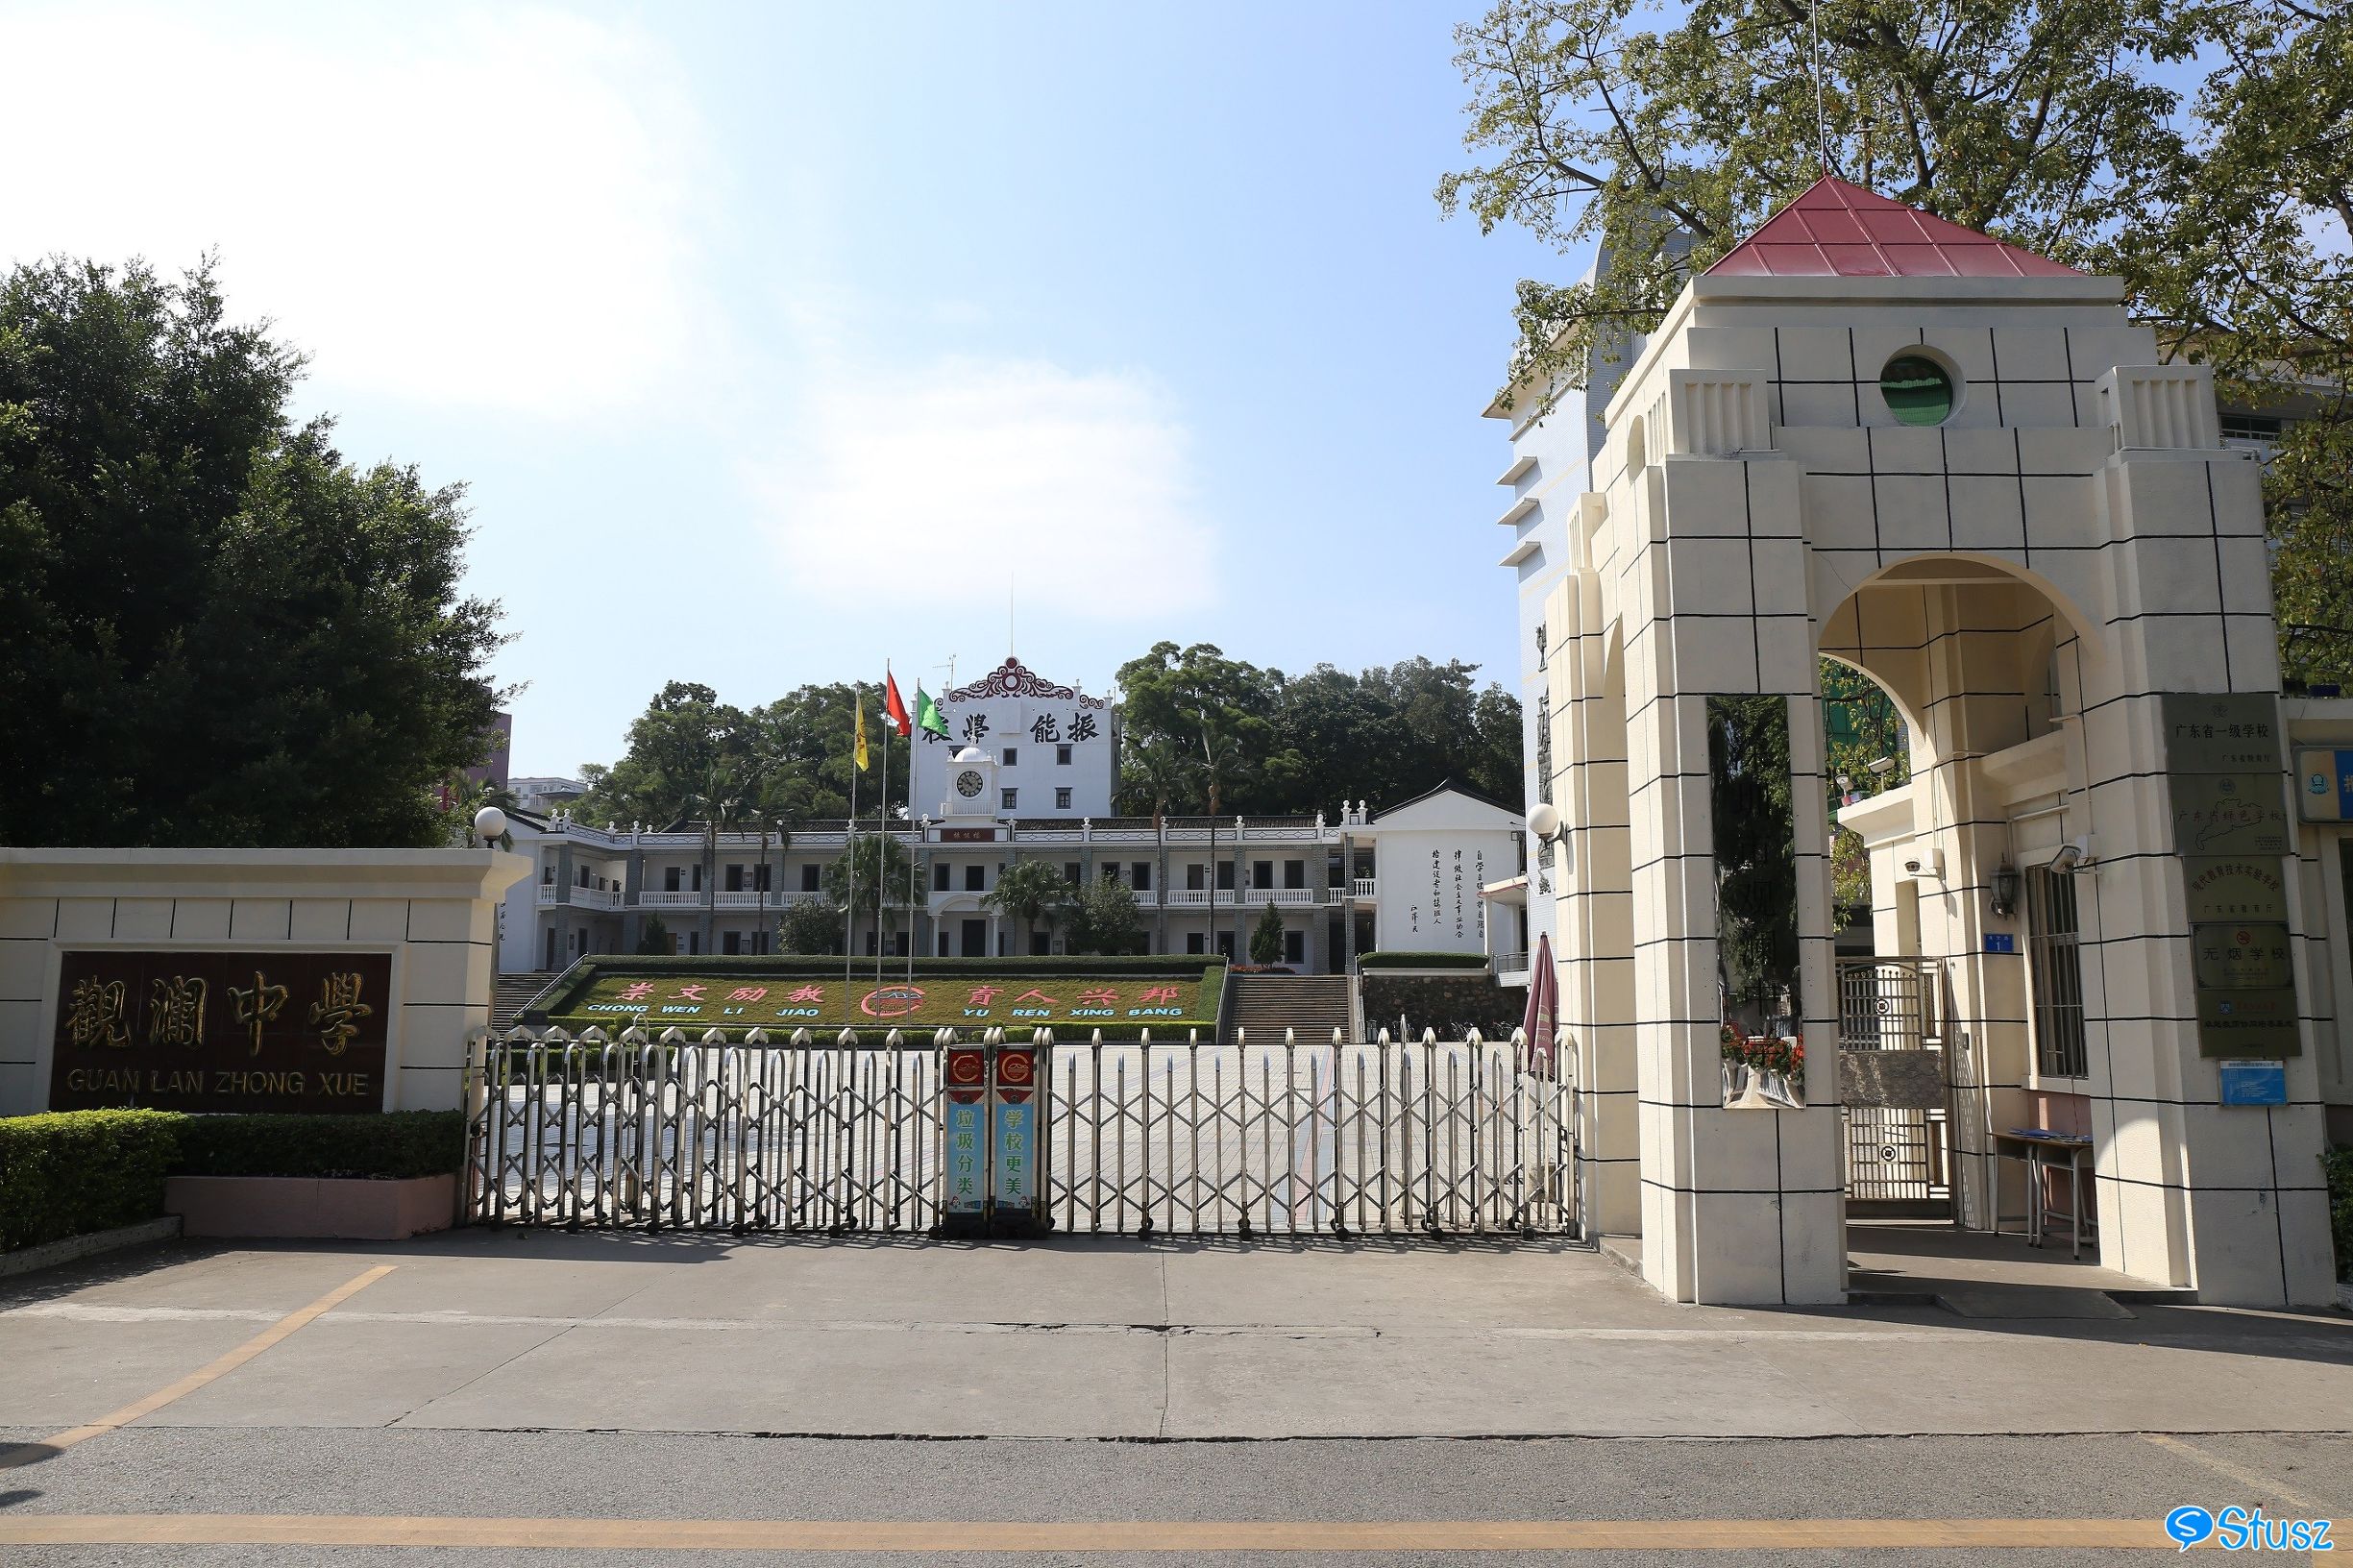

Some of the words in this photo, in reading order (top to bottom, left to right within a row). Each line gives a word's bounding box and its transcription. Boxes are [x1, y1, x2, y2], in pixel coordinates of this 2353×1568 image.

[2175, 723, 2268, 739] 广东省一级学校
[2204, 946, 2285, 962] 无烟学校
[967, 985, 1179, 1006] 育人兴邦
[587, 1003, 650, 1013] CHONG
[661, 1005, 701, 1014] WEN
[723, 1006, 744, 1016] LI
[776, 1007, 819, 1017] JIAO
[964, 1008, 989, 1017] YU
[1012, 1008, 1050, 1017] REN
[1070, 1008, 1115, 1017] XING
[1129, 1007, 1183, 1016] BANG
[66, 1067, 140, 1094] GUAN
[150, 1068, 204, 1094] LAN
[214, 1069, 306, 1095] ZHONG
[318, 1071, 370, 1095] XUE
[956, 1109, 974, 1195] 垃圾分类
[1005, 1109, 1022, 1195] 学校更美
